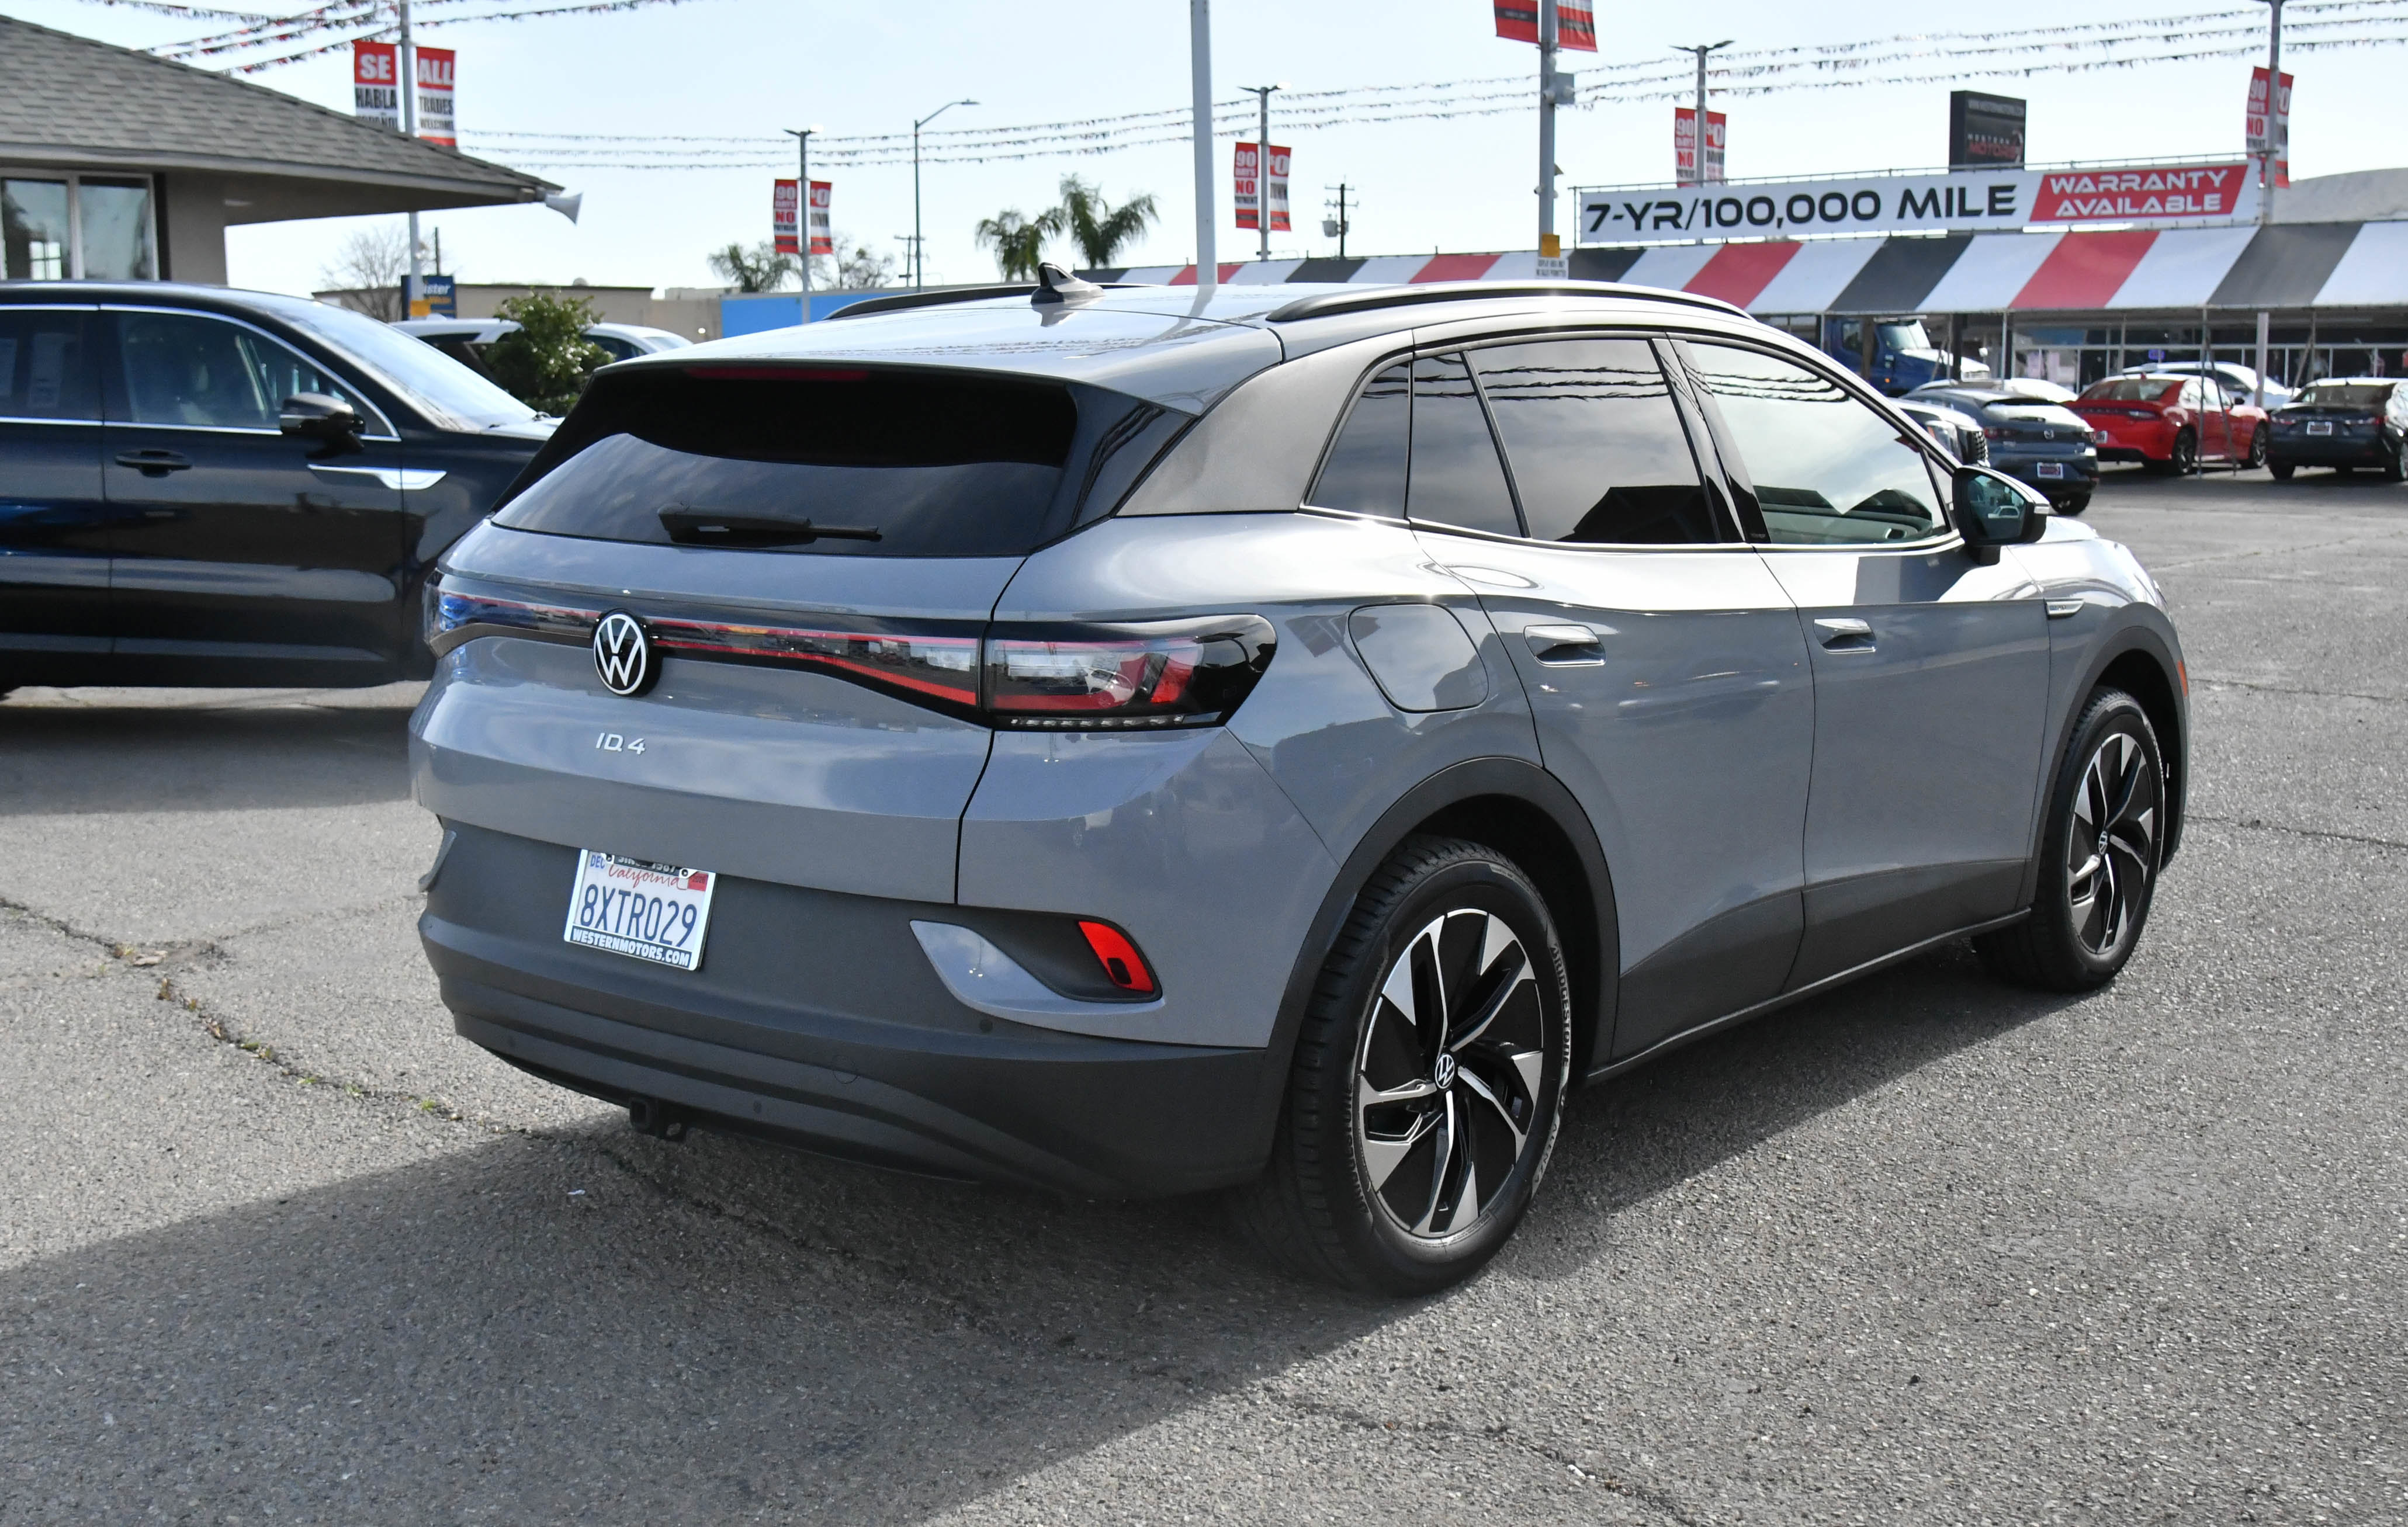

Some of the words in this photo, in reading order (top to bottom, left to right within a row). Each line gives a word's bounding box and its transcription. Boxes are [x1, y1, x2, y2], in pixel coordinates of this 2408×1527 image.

[359, 53, 391, 80] SE
[418, 58, 453, 86] ALL
[355, 88, 397, 110] HABLA
[418, 95, 453, 116] TRADES
[1676, 117, 1694, 136] 90
[1235, 150, 1256, 167] 90
[1678, 151, 1693, 168] NO
[1236, 180, 1255, 195] NO
[2050, 169, 2227, 195] WARRANTY
[1586, 189, 1881, 232] 7-YR/100,000
[1897, 184, 2017, 219] MILE
[2055, 193, 2221, 217] AVAILABLE
[775, 211, 795, 223] NO
[590, 855, 605, 869] DEC
[608, 865, 687, 889] California
[580, 884, 698, 948] 8XTR029
[572, 929, 690, 967] WESTERNMOTORS.COM
